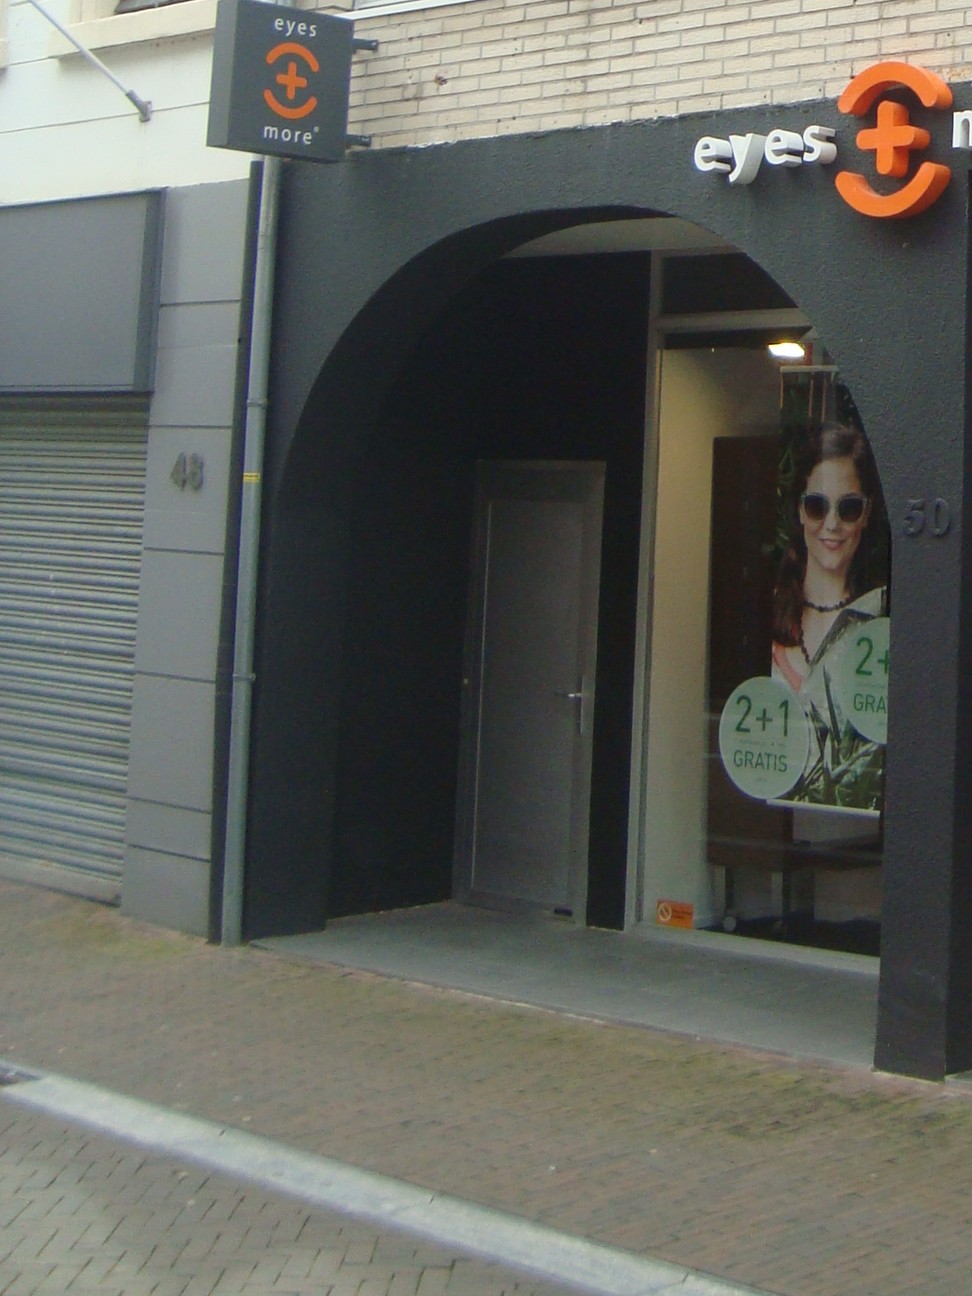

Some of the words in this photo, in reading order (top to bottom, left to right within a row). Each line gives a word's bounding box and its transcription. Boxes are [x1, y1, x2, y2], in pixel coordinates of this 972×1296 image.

[274, 17, 317, 37] eyes
[263, 125, 313, 145] more
[694, 124, 837, 185] eyes
[169, 451, 206, 492] 48
[902, 497, 952, 536] 50
[735, 694, 790, 737] 2+1
[733, 748, 789, 773] GRATIS
